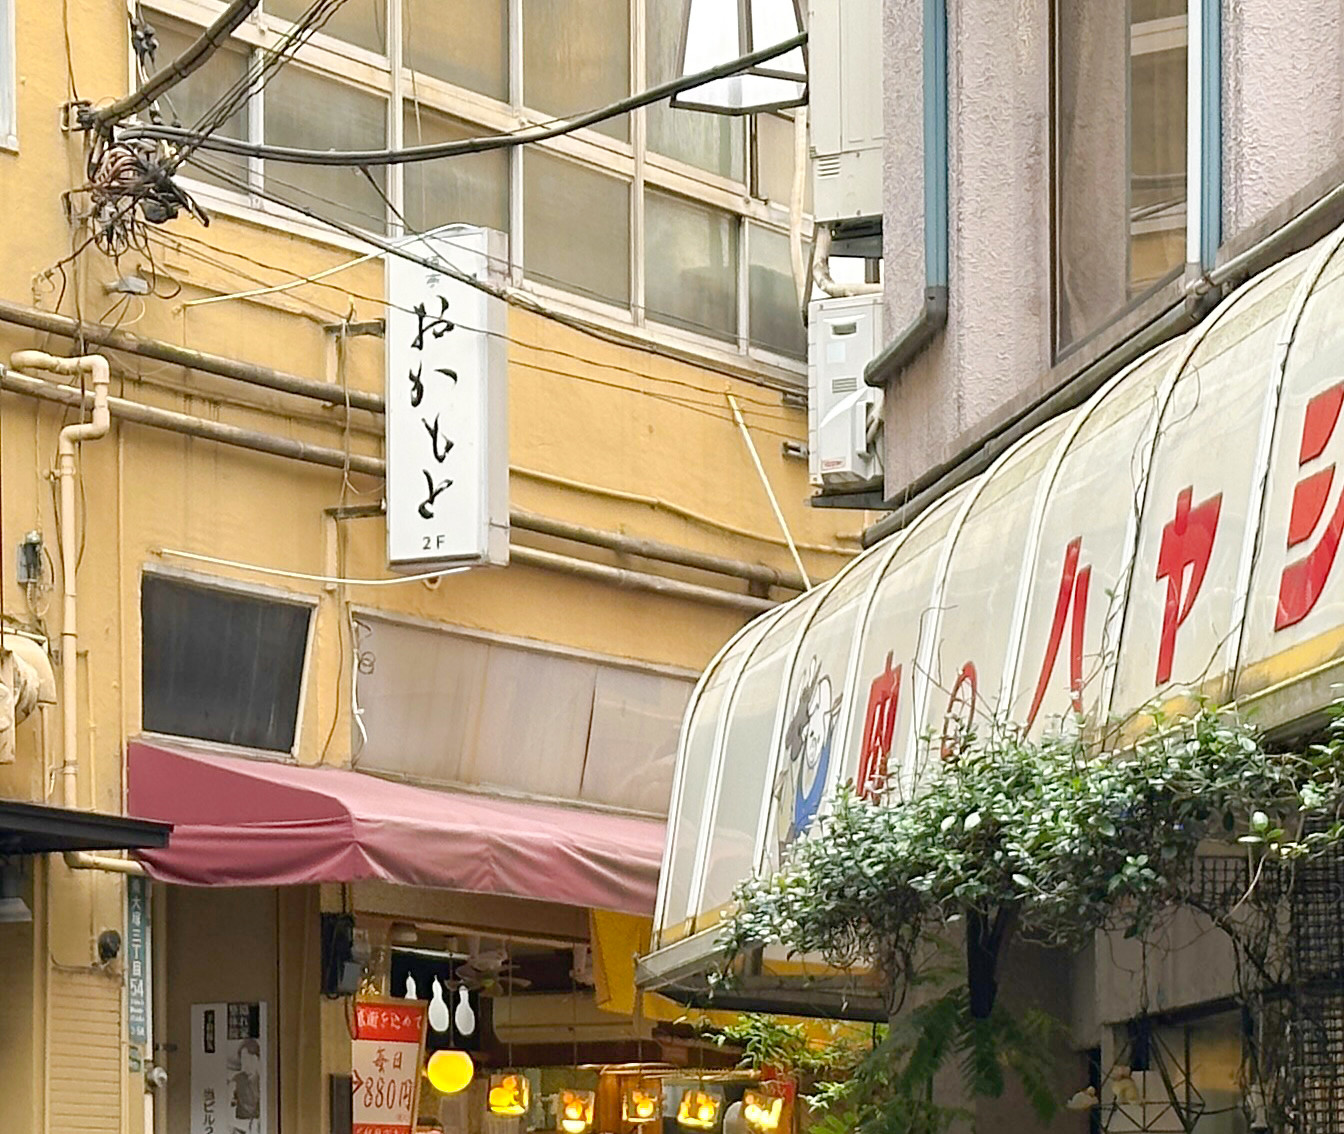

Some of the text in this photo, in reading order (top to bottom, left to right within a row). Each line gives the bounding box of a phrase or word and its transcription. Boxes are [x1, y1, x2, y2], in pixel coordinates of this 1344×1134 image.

[408, 295, 459, 520] おかもと
[422, 534, 446, 550] 2F
[363, 1076, 413, 1112] 880円
